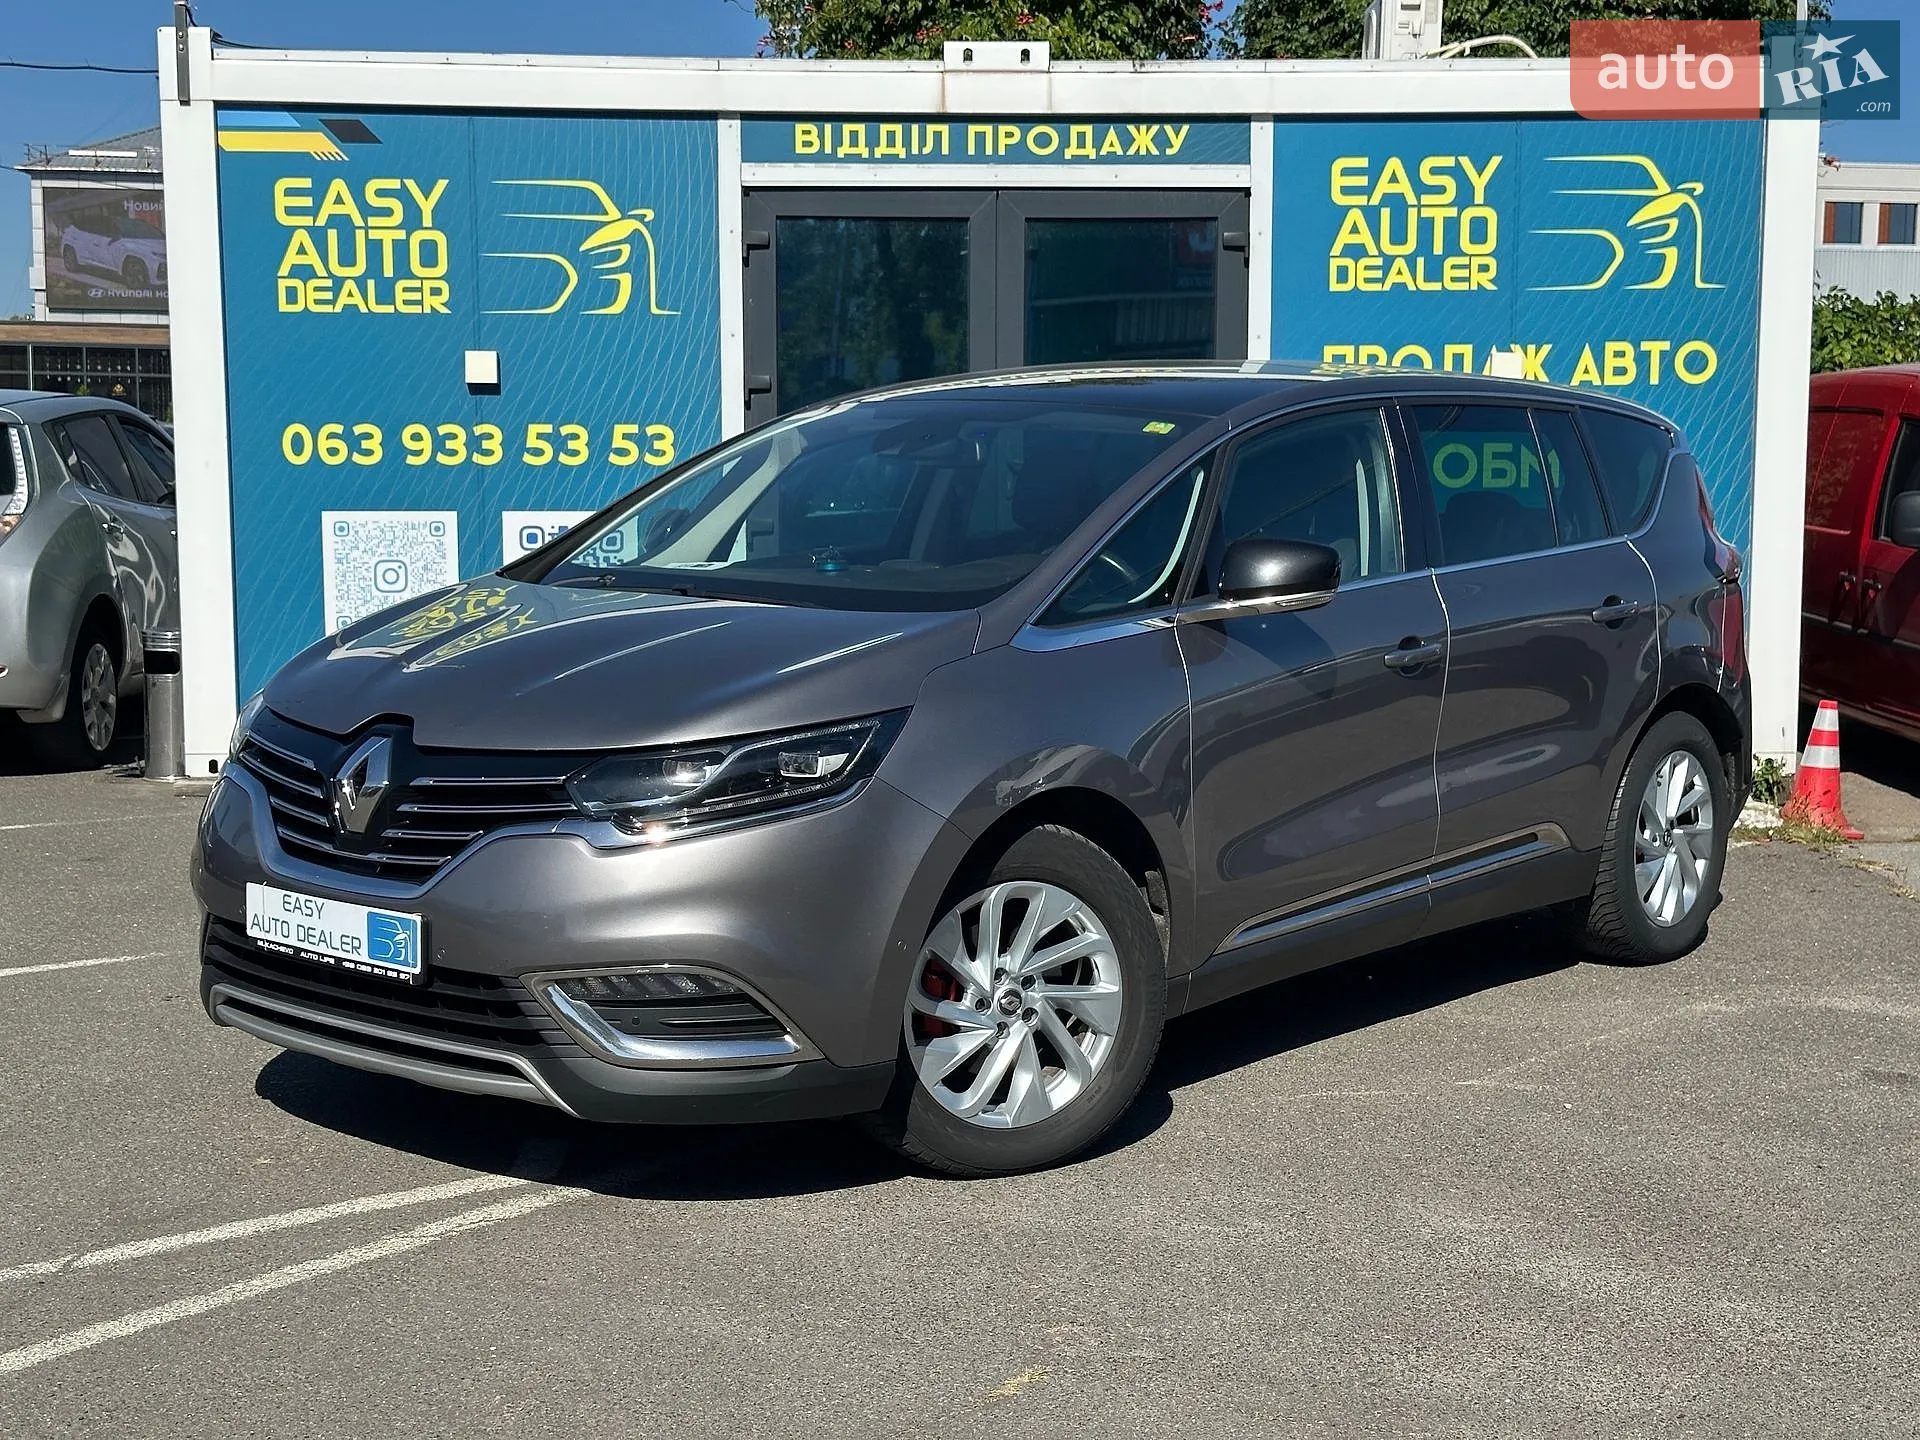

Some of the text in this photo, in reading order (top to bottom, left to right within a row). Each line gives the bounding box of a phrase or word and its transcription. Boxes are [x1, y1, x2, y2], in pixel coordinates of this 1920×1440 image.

[794, 123, 1190, 160] ВІДДІЛ ПРОДАЖУ
[274, 177, 449, 227] EASY
[1331, 155, 1503, 206] EASY
[278, 228, 448, 278] AUTO
[1330, 206, 1498, 257] AUTO
[277, 278, 451, 313] DEALER
[1329, 256, 1498, 292] DEALER
[1570, 340, 1719, 386] АВТО
[282, 423, 675, 466] 063 933 53 53
[282, 893, 325, 919] EASY
[251, 912, 362, 956] AUTO DEALER
